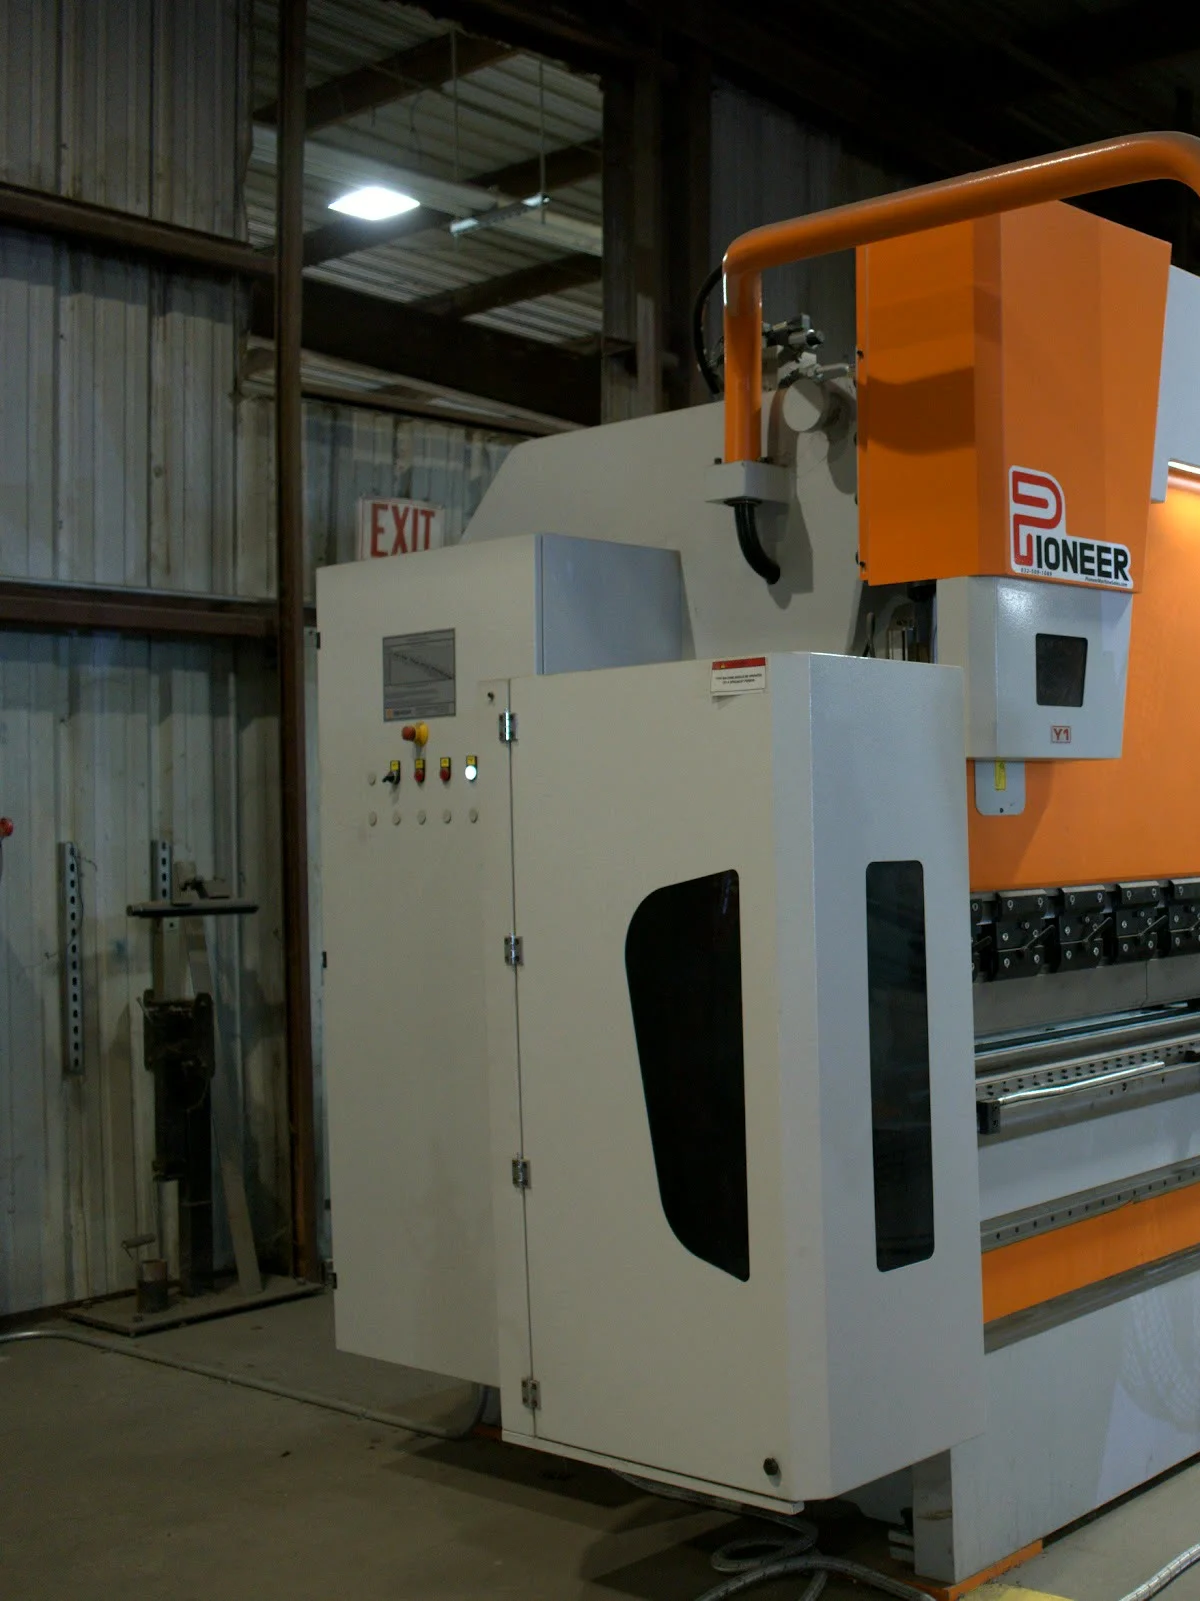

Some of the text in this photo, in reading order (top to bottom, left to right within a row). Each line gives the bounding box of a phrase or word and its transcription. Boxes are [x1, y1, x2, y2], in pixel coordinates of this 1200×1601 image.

[371, 503, 435, 557] EXIT
[1012, 470, 1129, 582] PIONEER
[1053, 728, 1069, 741] Y1
